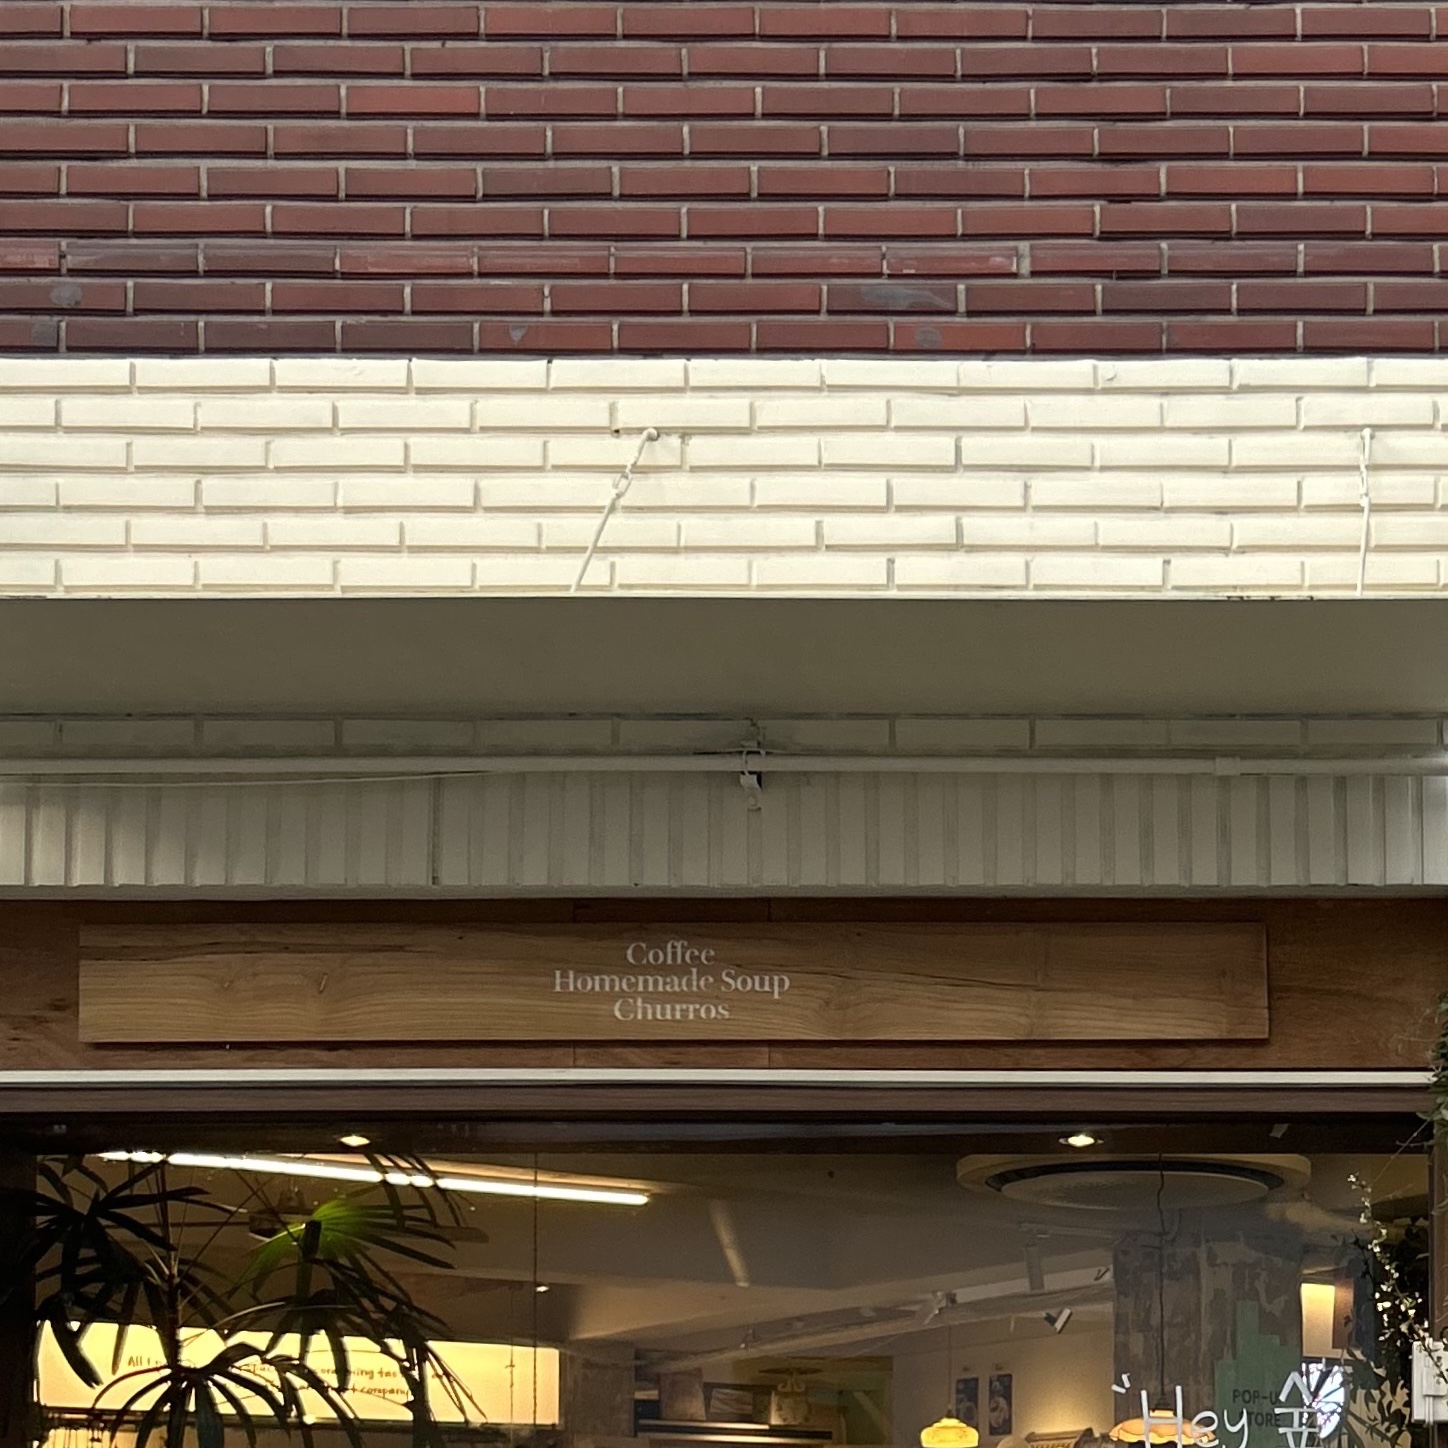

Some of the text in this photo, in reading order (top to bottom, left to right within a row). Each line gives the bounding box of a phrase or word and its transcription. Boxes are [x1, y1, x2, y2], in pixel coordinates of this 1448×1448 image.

[626, 940, 715, 965] Coffee
[554, 969, 790, 999] Homemade Soup
[613, 998, 731, 1020] Churros
[1232, 1389, 1284, 1405] POP-U
[1240, 1409, 1282, 1427] TORE
